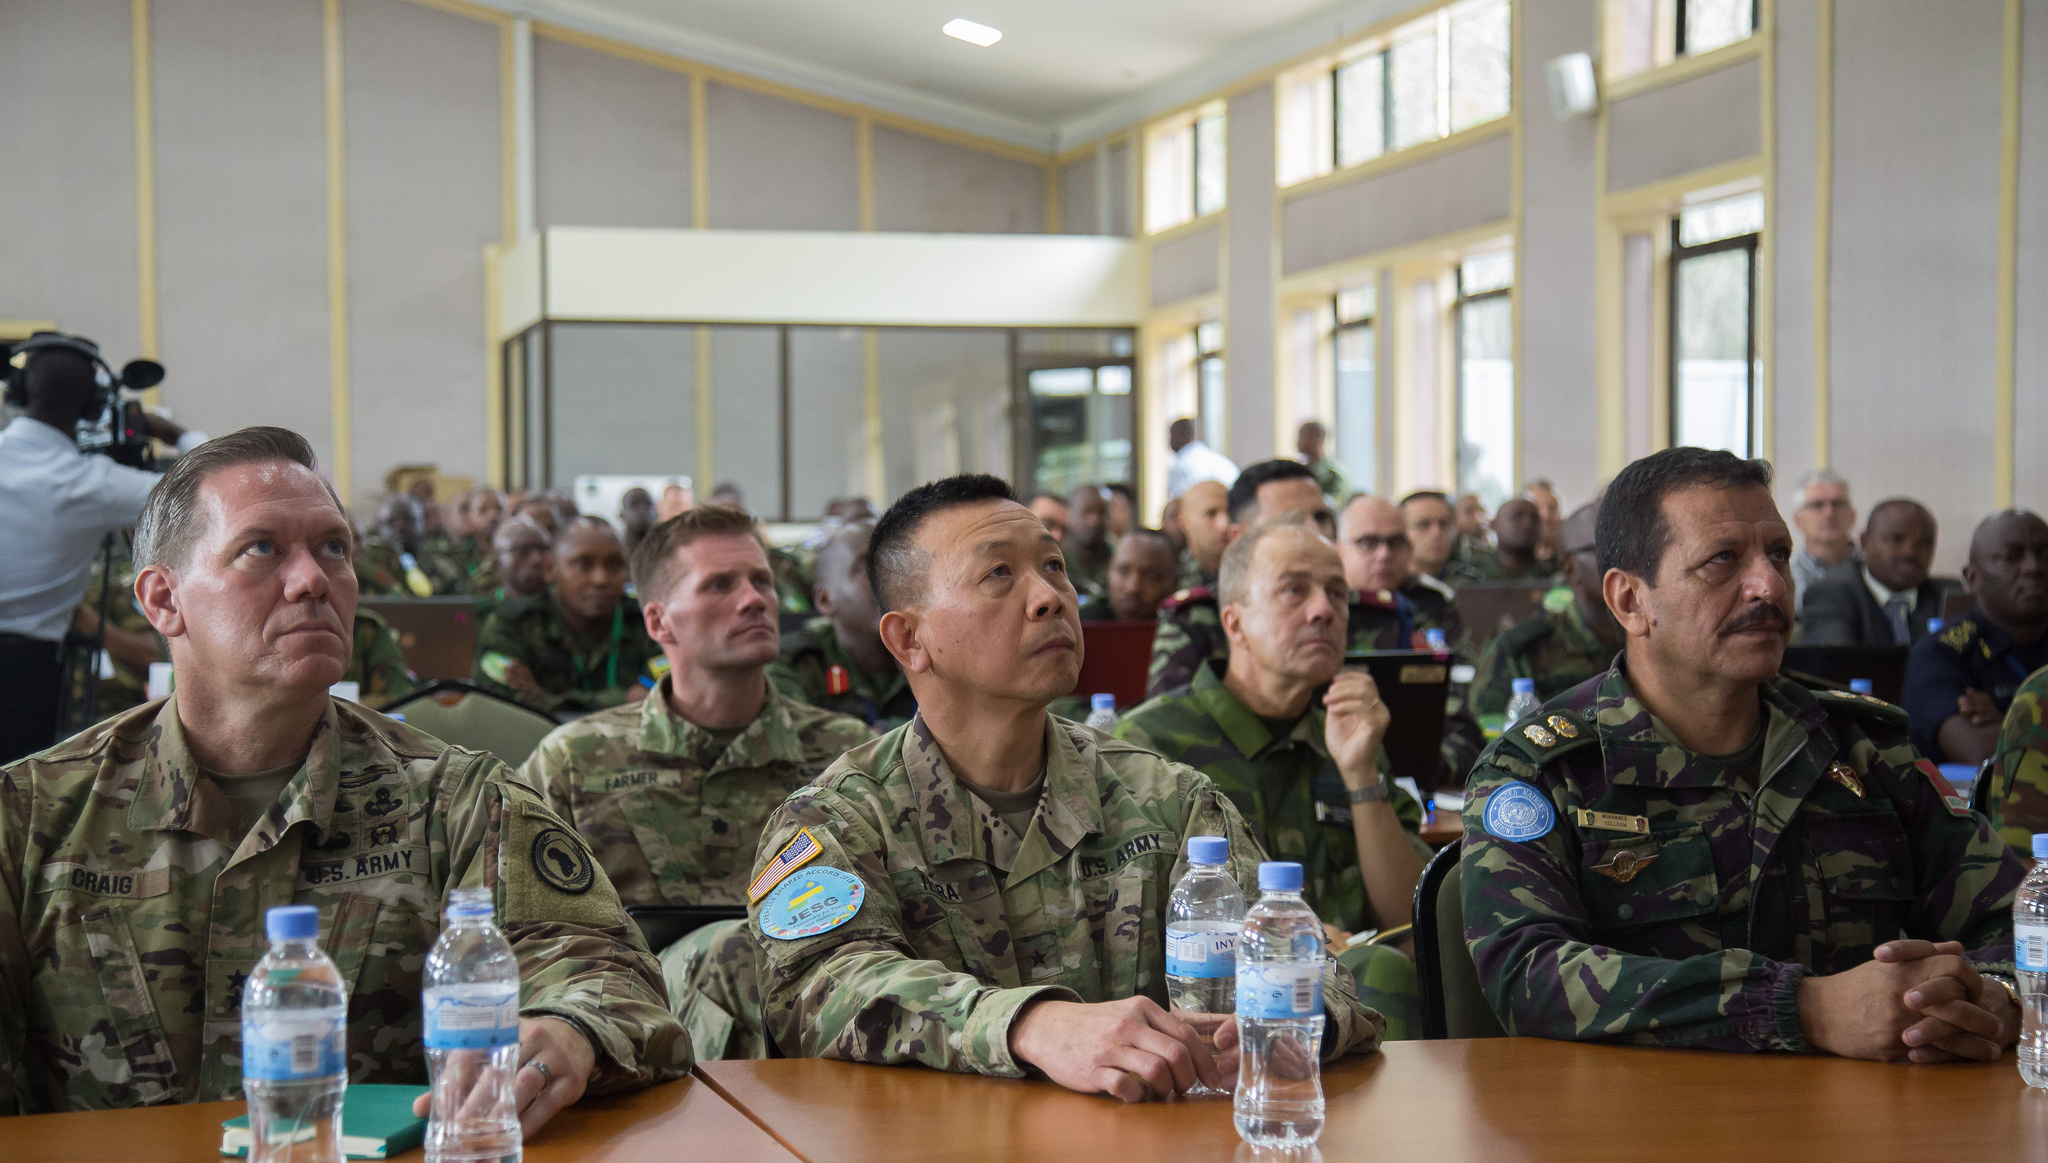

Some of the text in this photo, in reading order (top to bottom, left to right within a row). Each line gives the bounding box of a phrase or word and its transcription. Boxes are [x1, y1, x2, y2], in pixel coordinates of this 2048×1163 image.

[605, 771, 658, 792] FARMER
[355, 850, 413, 877] ARMY
[1082, 833, 1160, 878] U.S. ARMY
[71, 868, 133, 895] CRAIG
[775, 874, 803, 897] SHARED
[806, 869, 840, 877] ACCORD
[788, 896, 839, 926] JESG
[1215, 938, 1235, 951] INY
